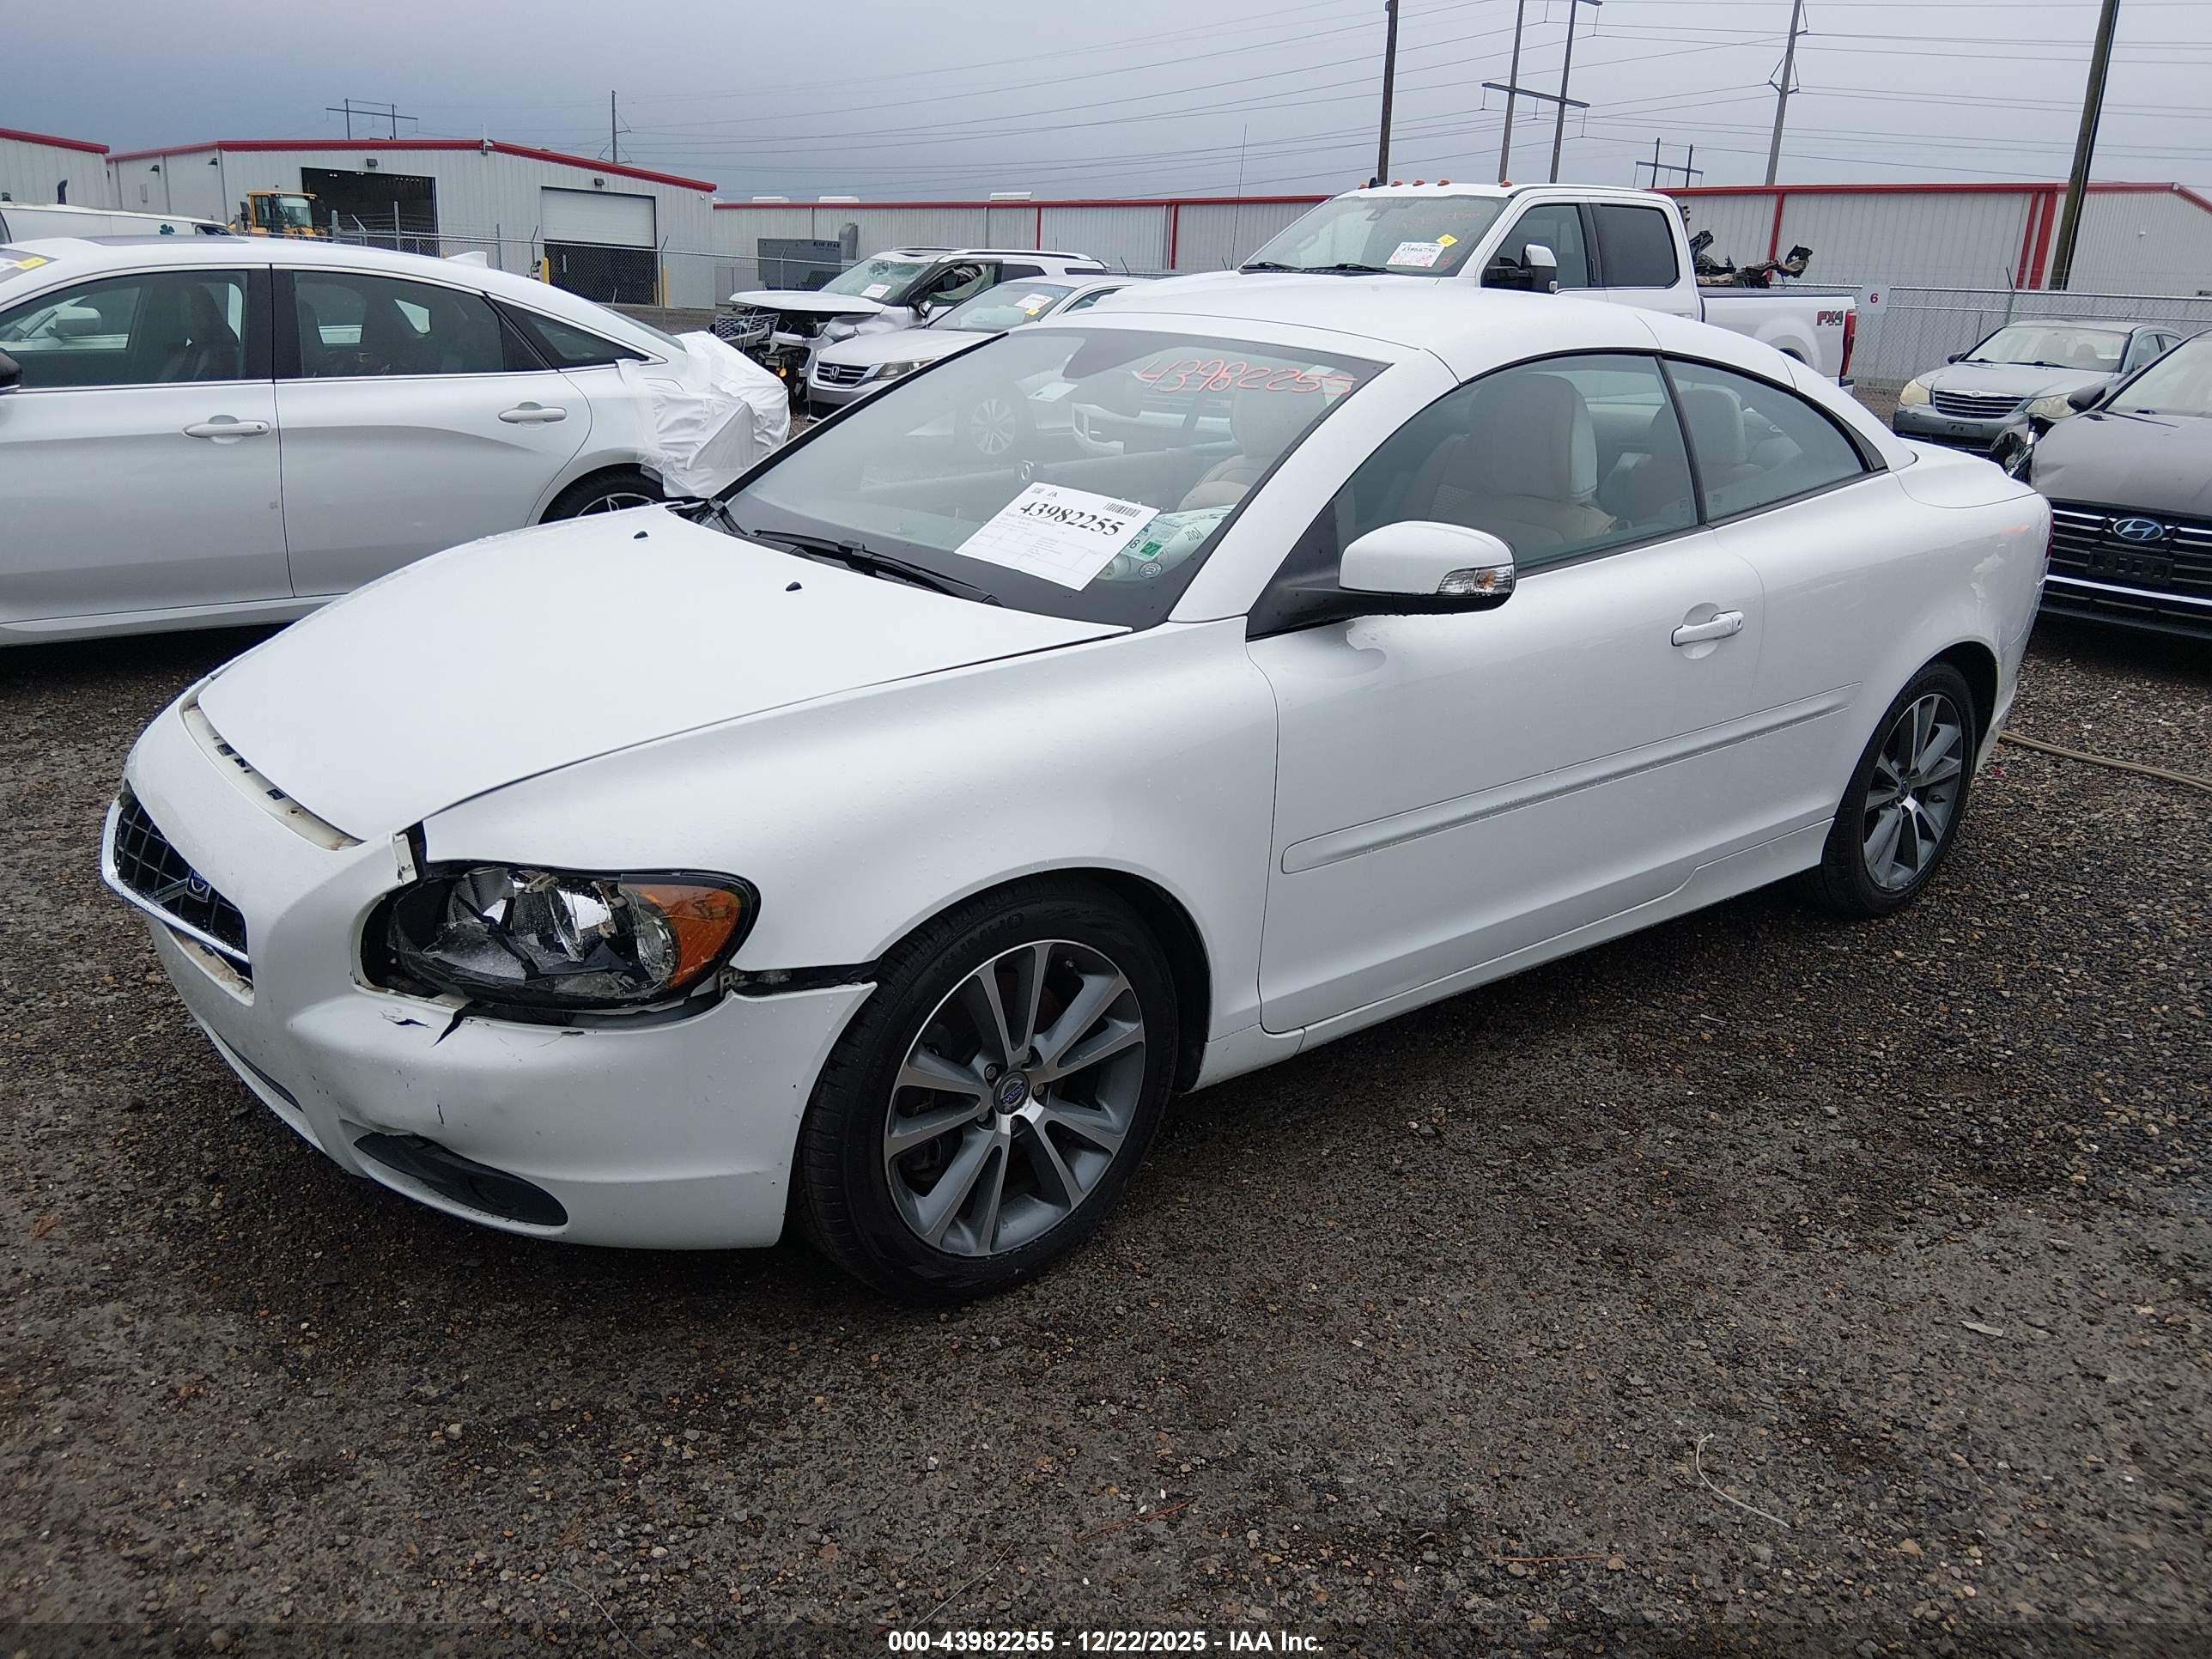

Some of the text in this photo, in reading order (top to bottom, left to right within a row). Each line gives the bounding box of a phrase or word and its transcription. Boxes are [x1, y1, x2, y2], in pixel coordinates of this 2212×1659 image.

[1869, 293, 1879, 304] 6
[1816, 310, 1844, 326] FX4
[1135, 357, 1358, 396] 43982255
[1019, 501, 1126, 537] 43982255
